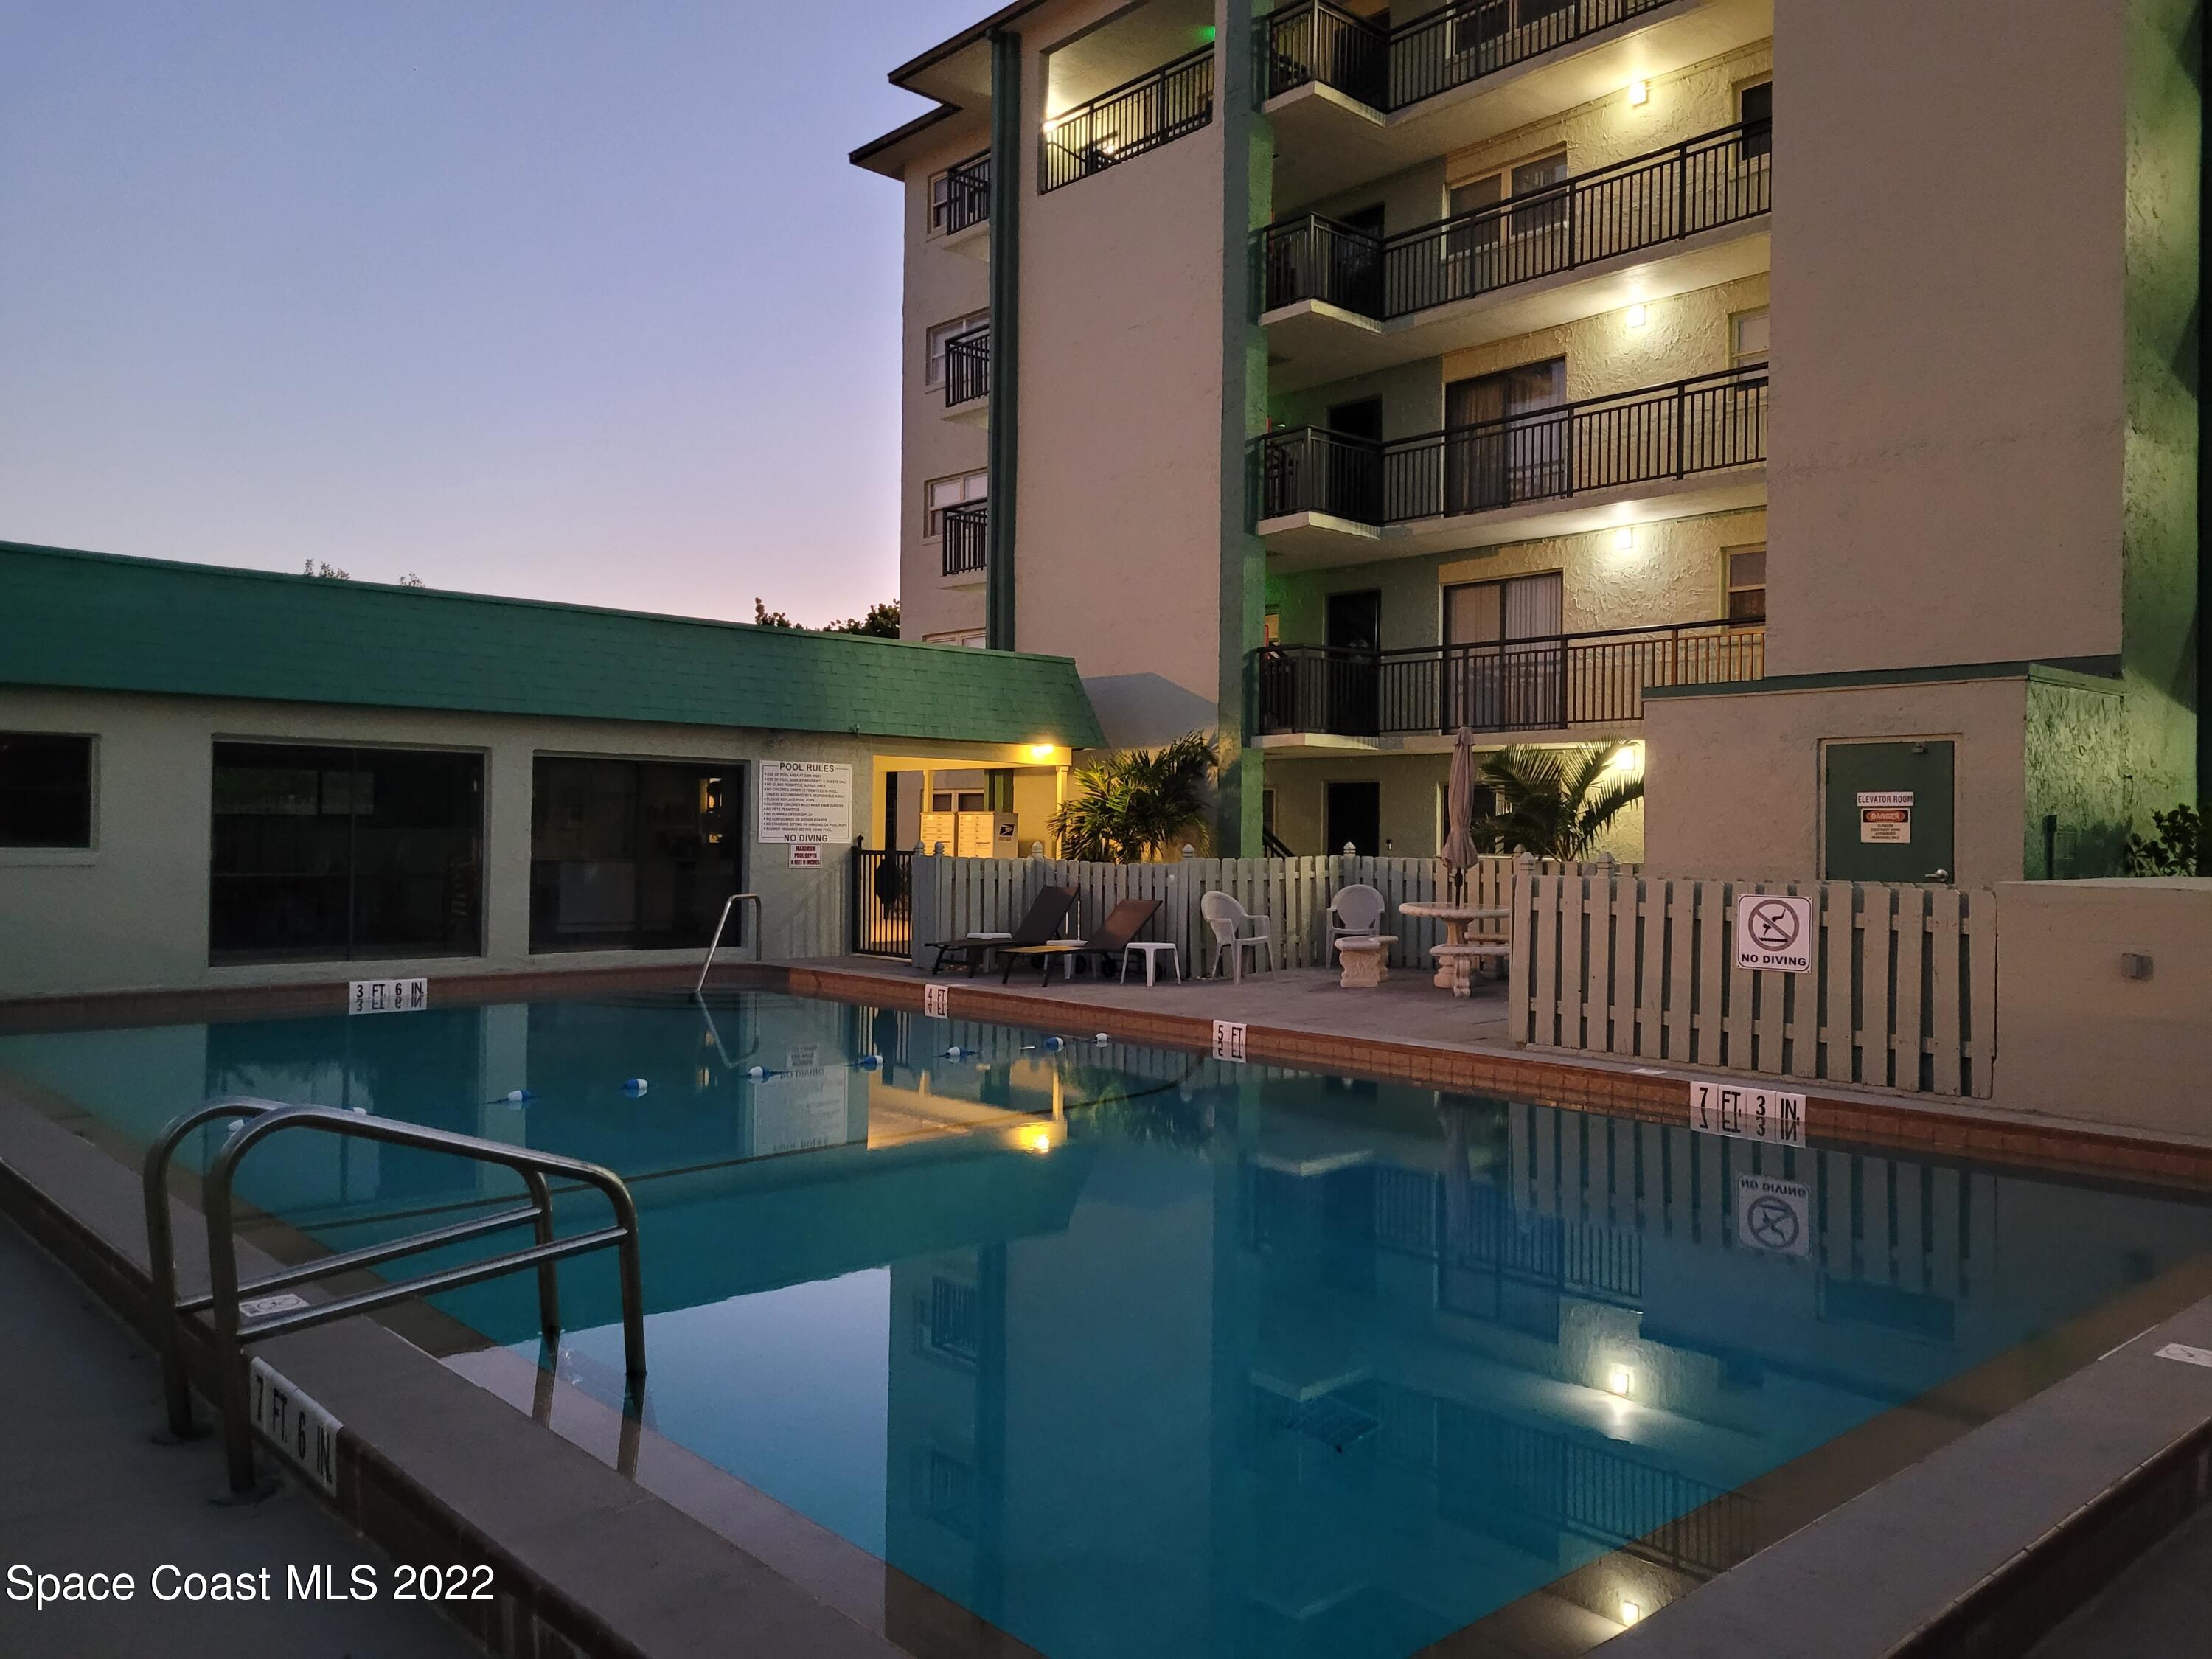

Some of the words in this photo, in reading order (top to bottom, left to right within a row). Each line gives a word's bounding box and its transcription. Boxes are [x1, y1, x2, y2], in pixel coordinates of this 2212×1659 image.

[1742, 954, 1759, 962] NO
[1763, 956, 1806, 966] DIVING
[357, 984, 364, 998] 3
[395, 983, 402, 995] 6
[928, 988, 932, 1001] 4
[1218, 1025, 1223, 1040] 5
[1700, 1087, 1708, 1108] 7
[1756, 1096, 1766, 1116] 3
[257, 1374, 263, 1422] 7
[298, 1411, 306, 1459] 6
